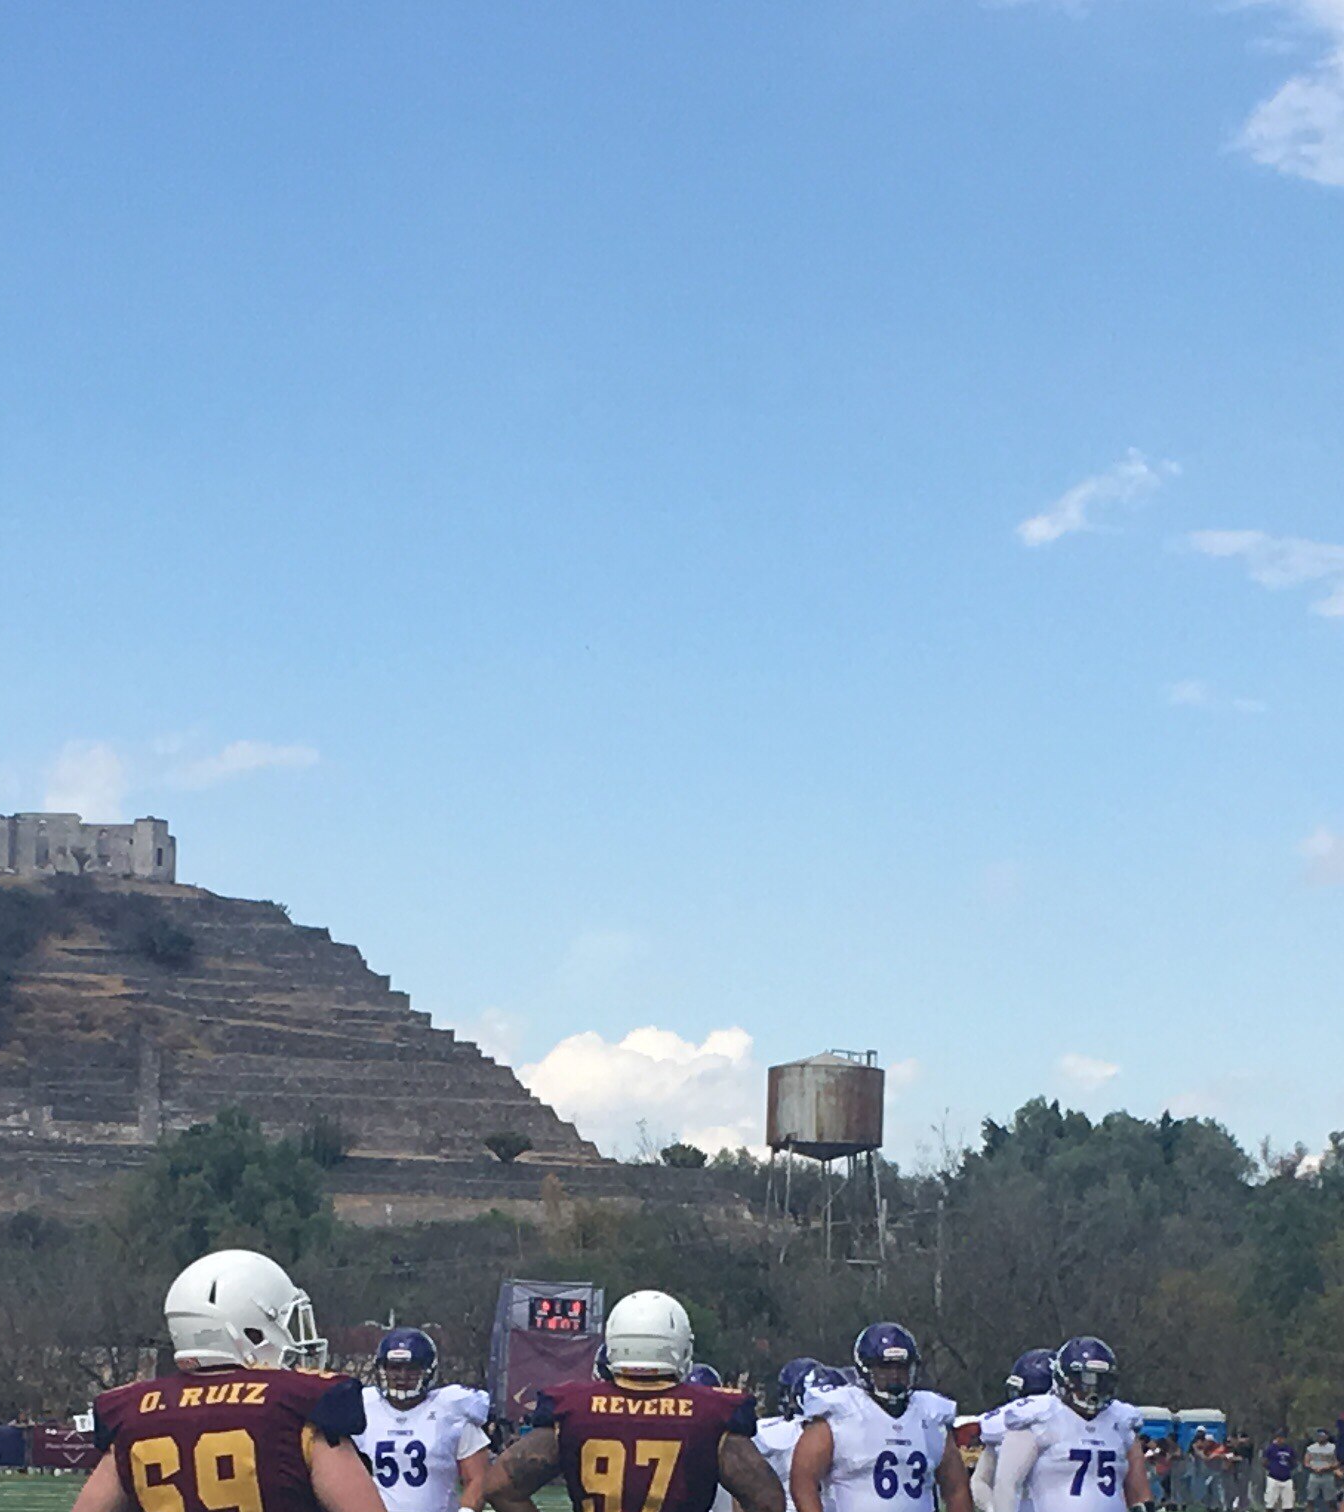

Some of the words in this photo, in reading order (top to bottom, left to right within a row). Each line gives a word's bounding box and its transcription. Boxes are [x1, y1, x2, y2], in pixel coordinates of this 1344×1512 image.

[179, 1382, 269, 1407] RUIZ
[591, 1395, 694, 1417] REVERE
[375, 1440, 428, 1488] 53
[873, 1450, 928, 1499] 63
[1069, 1449, 1116, 1497] 75
